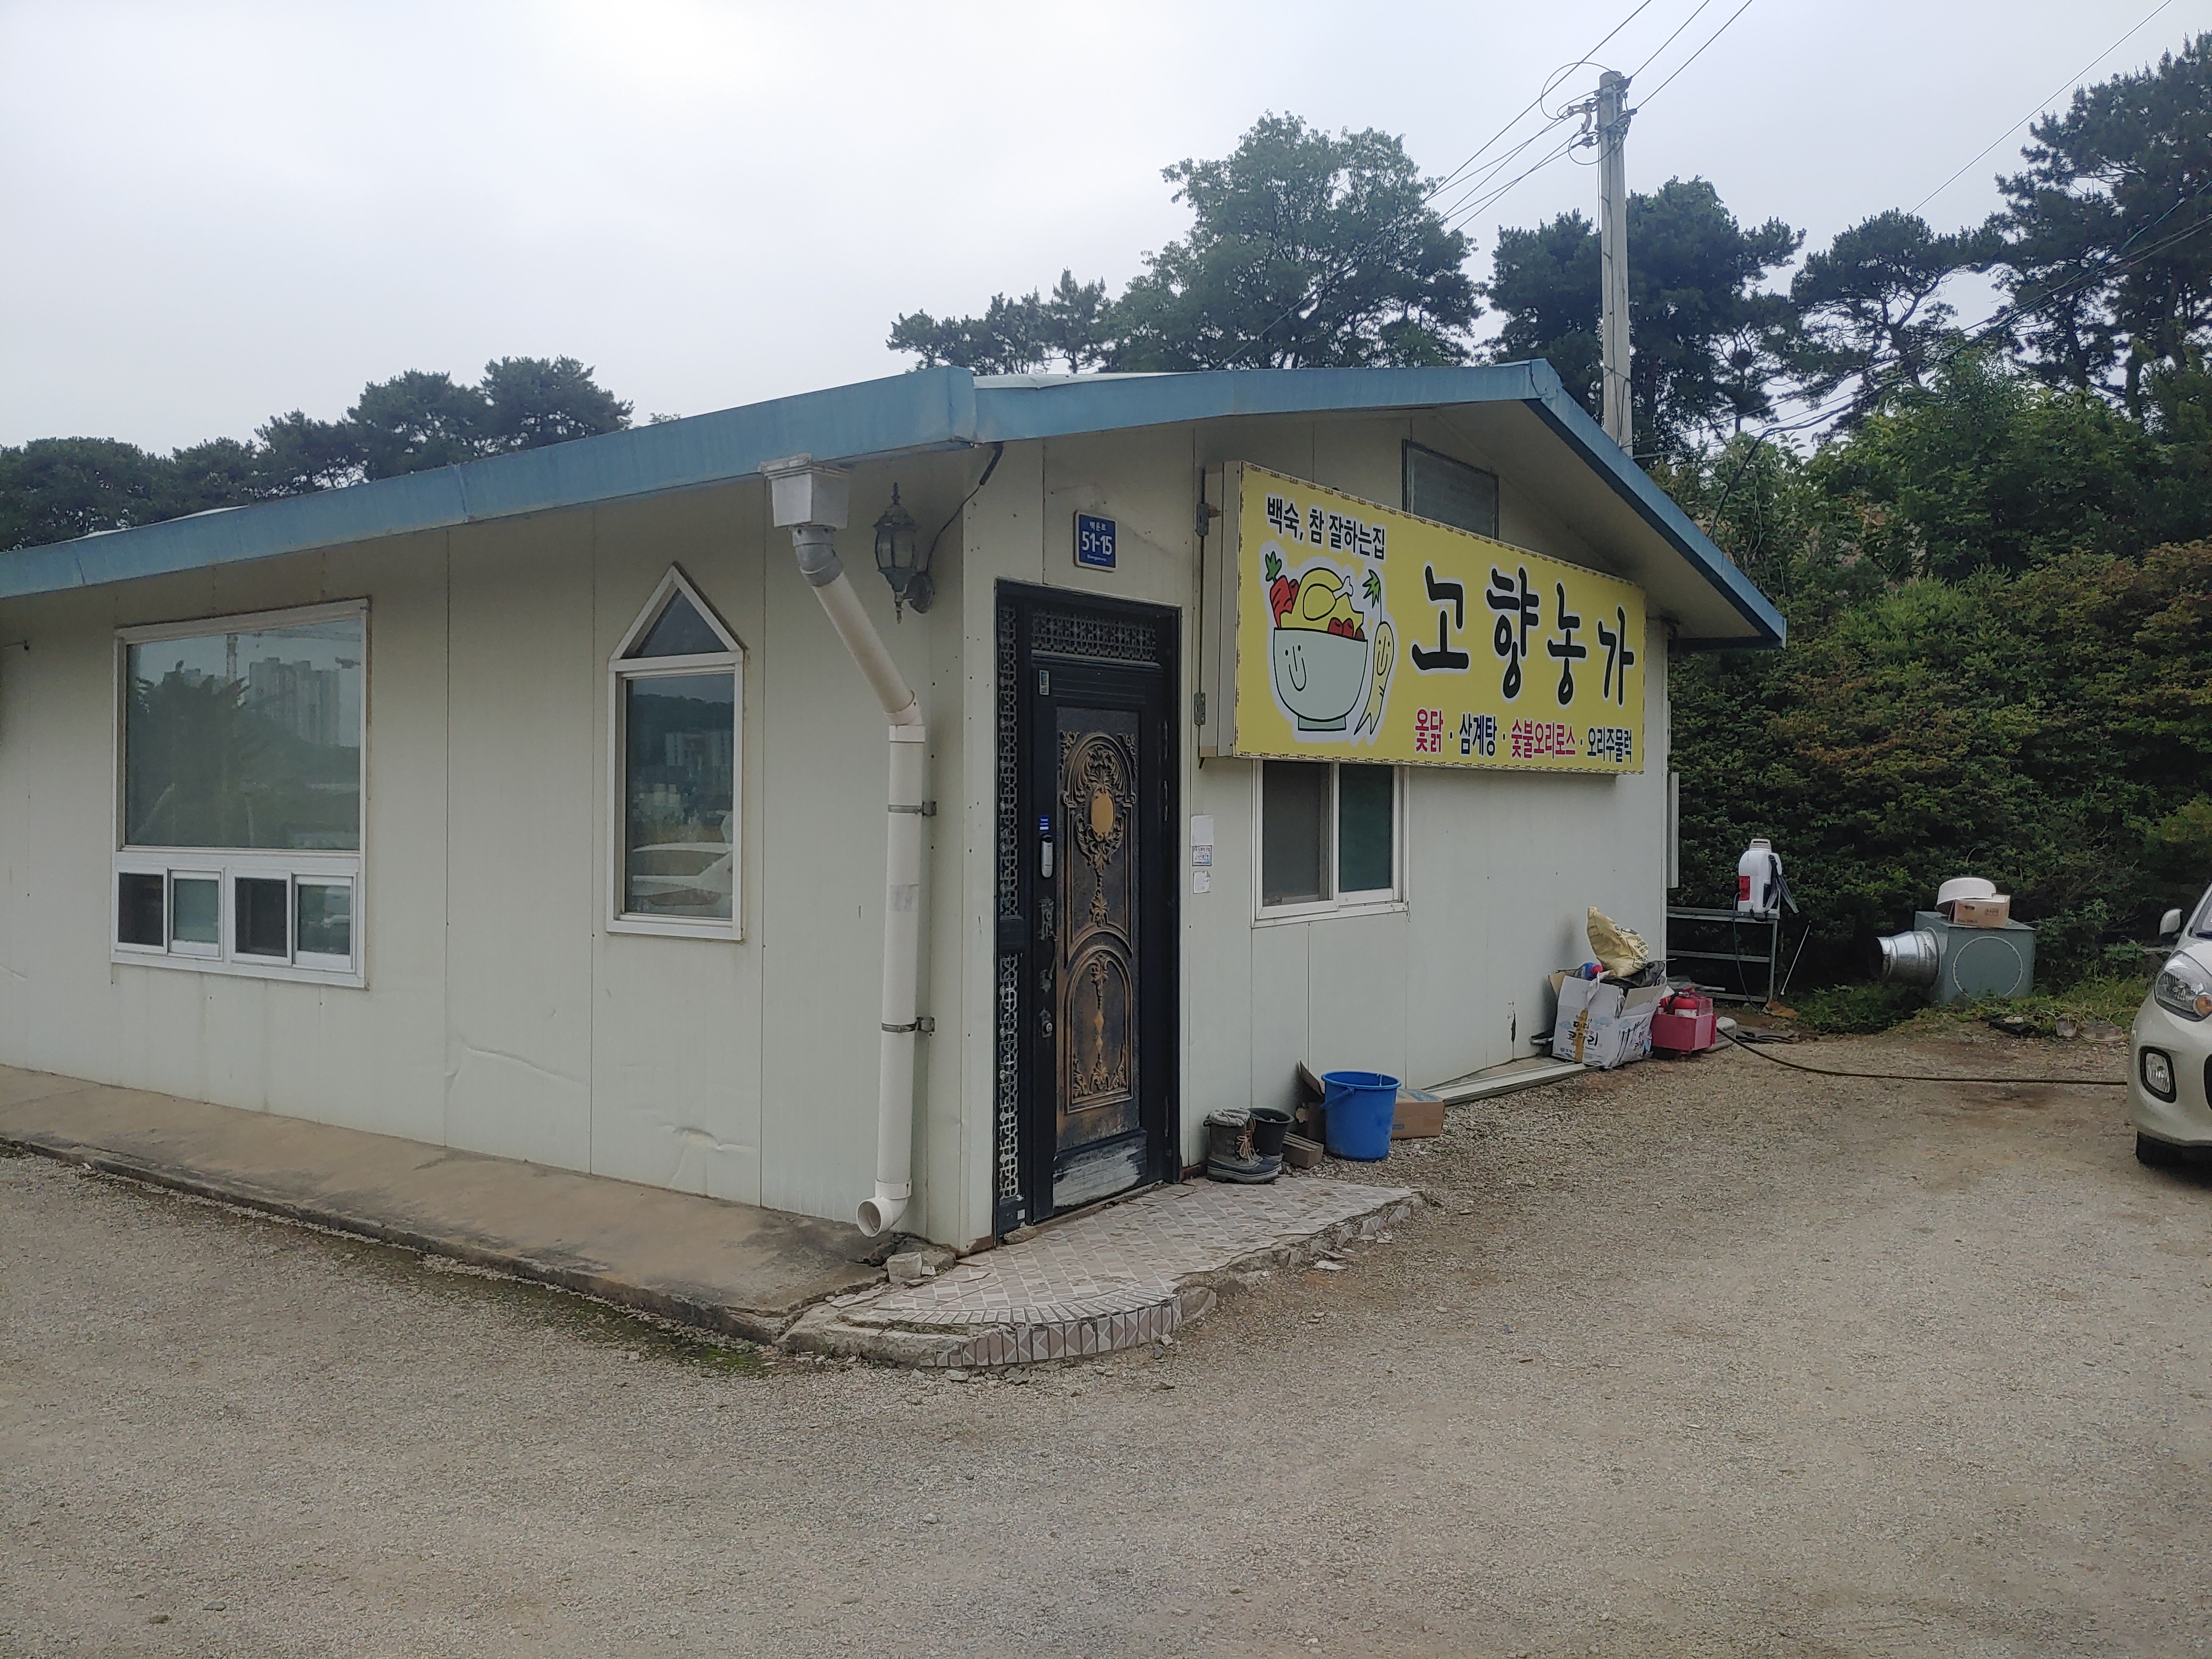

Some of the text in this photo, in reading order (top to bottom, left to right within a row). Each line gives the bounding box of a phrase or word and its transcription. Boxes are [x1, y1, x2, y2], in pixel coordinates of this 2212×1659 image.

[1081, 531, 1112, 555] 51-15
[1267, 496, 1385, 561] 백숙, 참 잘하는집
[1412, 565, 1635, 706] 고향농가
[1414, 708, 1632, 764] 옻닭 삼계탕 숯불오리로스 오리주물럭
